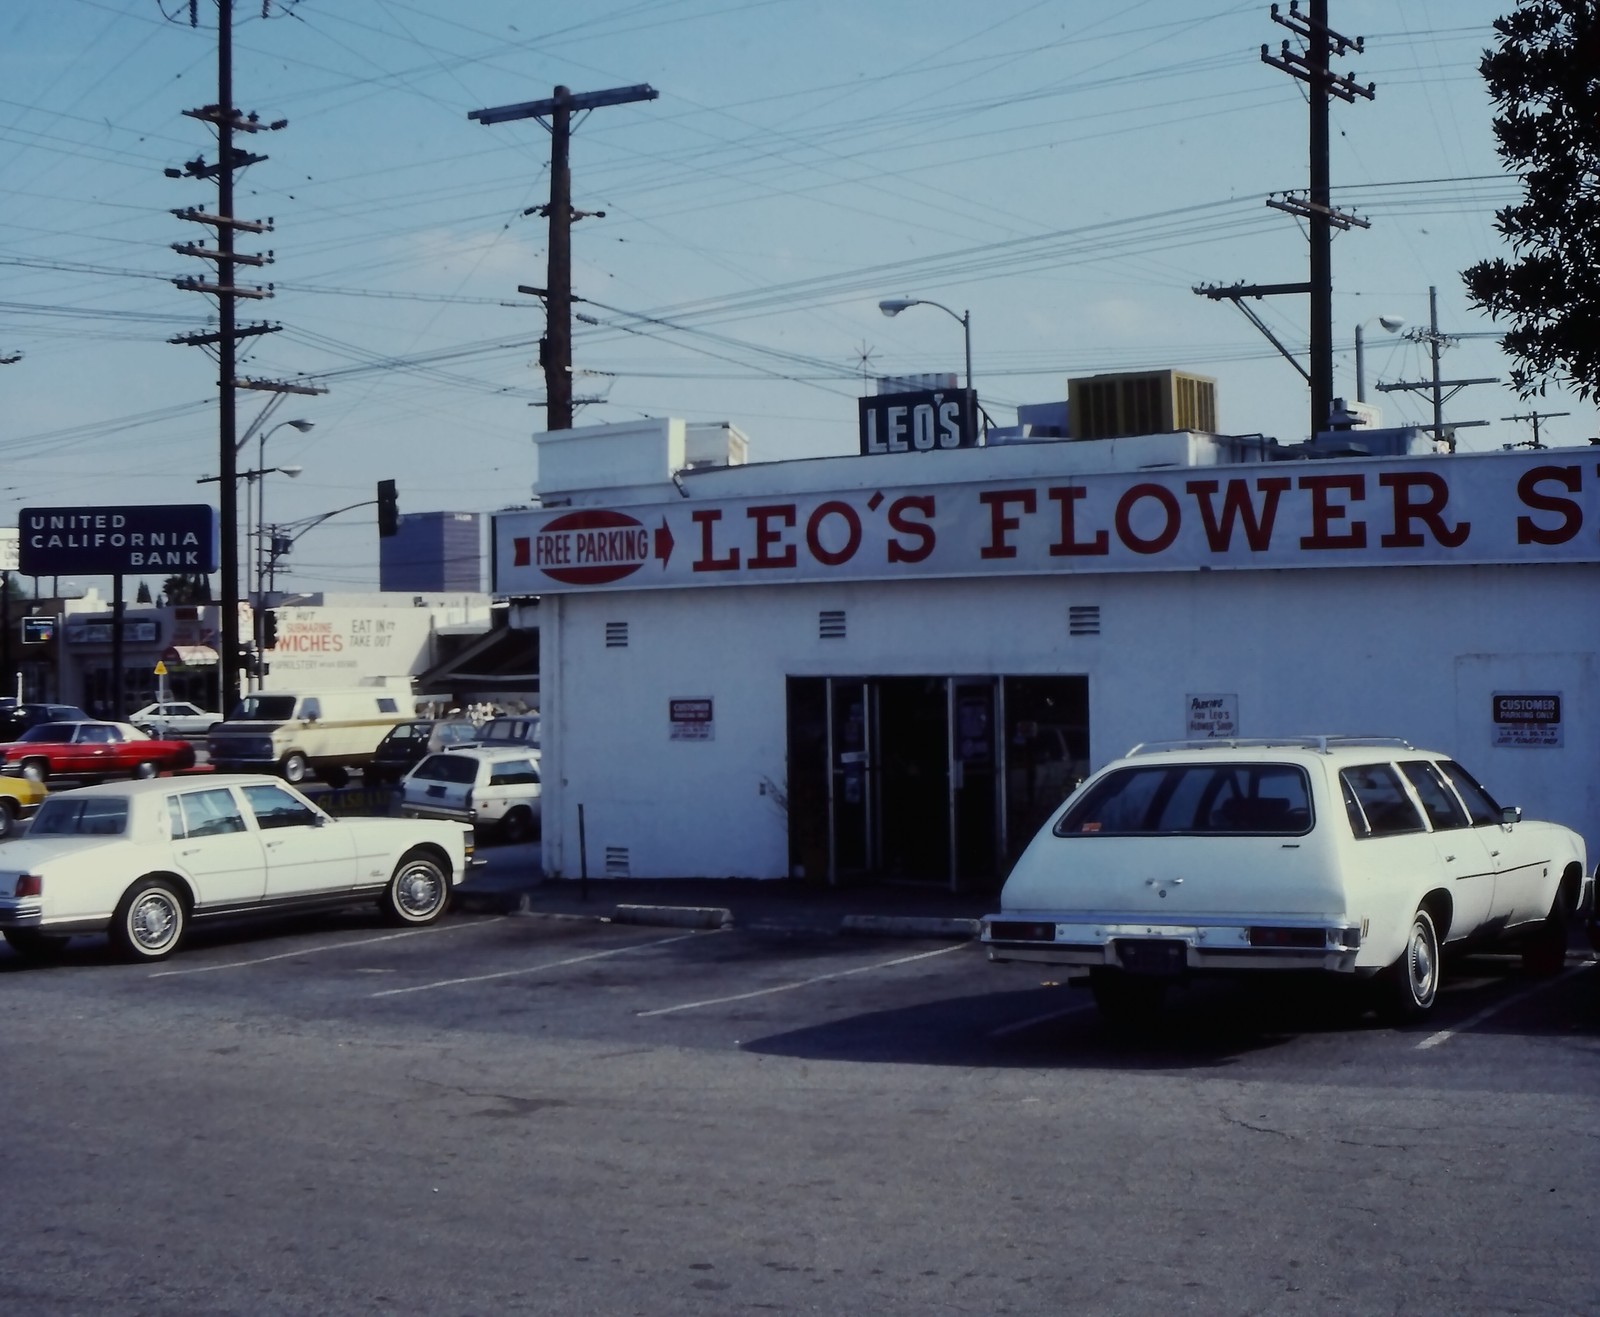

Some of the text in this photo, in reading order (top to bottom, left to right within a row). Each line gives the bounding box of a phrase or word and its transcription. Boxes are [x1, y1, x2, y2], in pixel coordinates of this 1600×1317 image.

[868, 393, 960, 453] LEO'S
[31, 514, 126, 530] UNITED
[692, 463, 1600, 572] LEO'S FLOWER S
[31, 531, 199, 549] CALIFORNIA
[536, 529, 649, 566] FREE PARKING
[130, 551, 199, 566] BANK
[286, 622, 333, 633] SUBMARINE
[352, 619, 372, 633] EAT
[376, 619, 385, 633] IN
[268, 634, 343, 652] WICHES
[349, 635, 392, 647] TAKE OUT
[1500, 699, 1555, 710] CUSTOMER
[1500, 711, 1554, 719] PARKING ONLY
